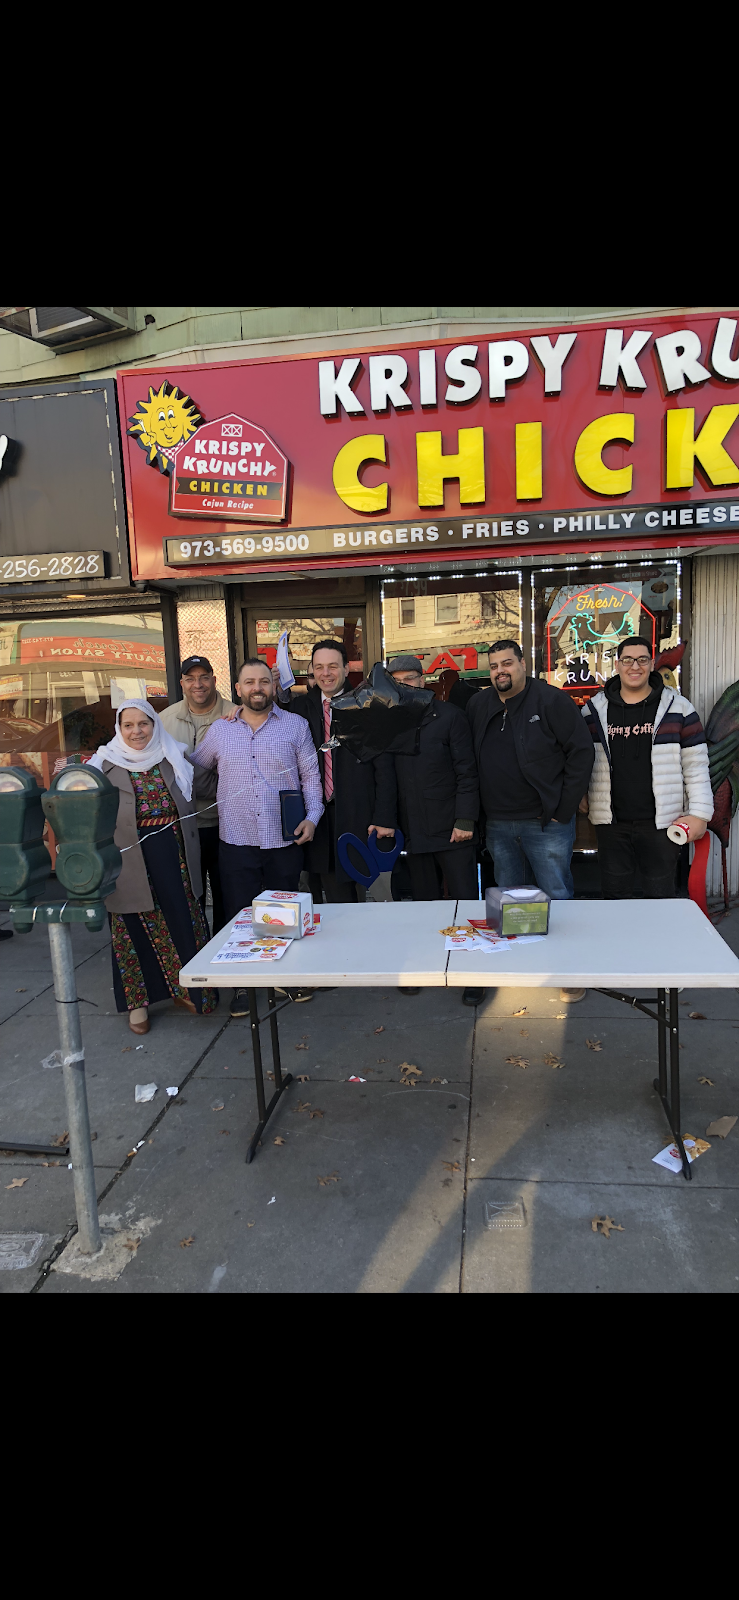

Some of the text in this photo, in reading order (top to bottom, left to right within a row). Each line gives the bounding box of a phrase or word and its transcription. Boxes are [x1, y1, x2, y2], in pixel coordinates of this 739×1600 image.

[318, 333, 577, 416] KRISPY
[194, 439, 265, 457] KRISPY
[332, 403, 739, 513] CHICK
[183, 455, 277, 477] KRUNCHY
[189, 480, 268, 496] CHICKEN
[202, 498, 254, 510] Cajun Recipe
[180, 505, 739, 558] 973-569-9500 BURGERS FRIES PHILLY CHEESE
[576, 594, 626, 611] Fresh!
